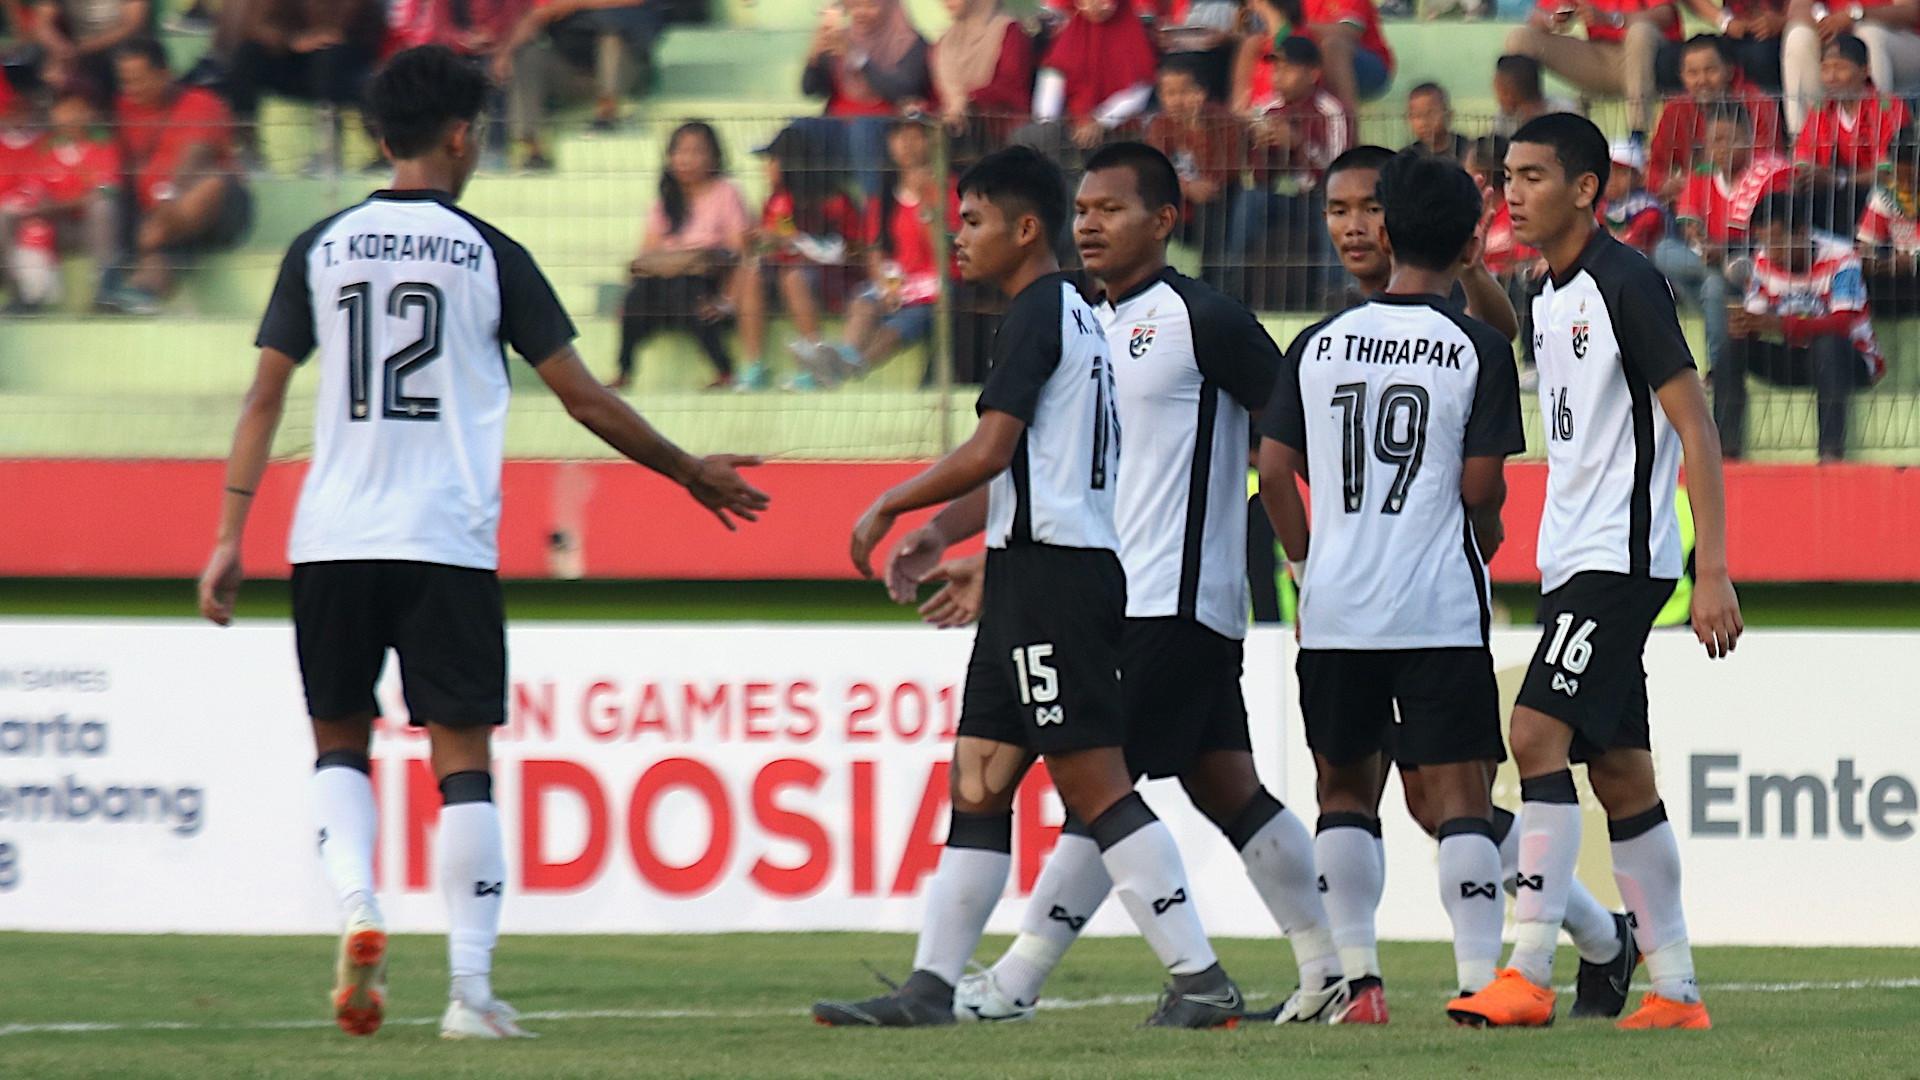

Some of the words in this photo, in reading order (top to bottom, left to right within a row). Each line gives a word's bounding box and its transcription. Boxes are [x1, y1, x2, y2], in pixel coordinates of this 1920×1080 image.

[322, 241, 339, 267] T.
[349, 234, 484, 272] KORAWICH
[338, 281, 444, 421] 12
[1317, 336, 1332, 360] P.
[1345, 335, 1466, 370] THIRAPAK
[1550, 386, 1574, 441] 16
[1331, 382, 1430, 514] 19
[1012, 643, 1059, 704] 15
[1545, 612, 1598, 675] 16
[581, 680, 820, 742] GAMES
[845, 681, 958, 742] 201
[1689, 754, 1919, 839] Emte
